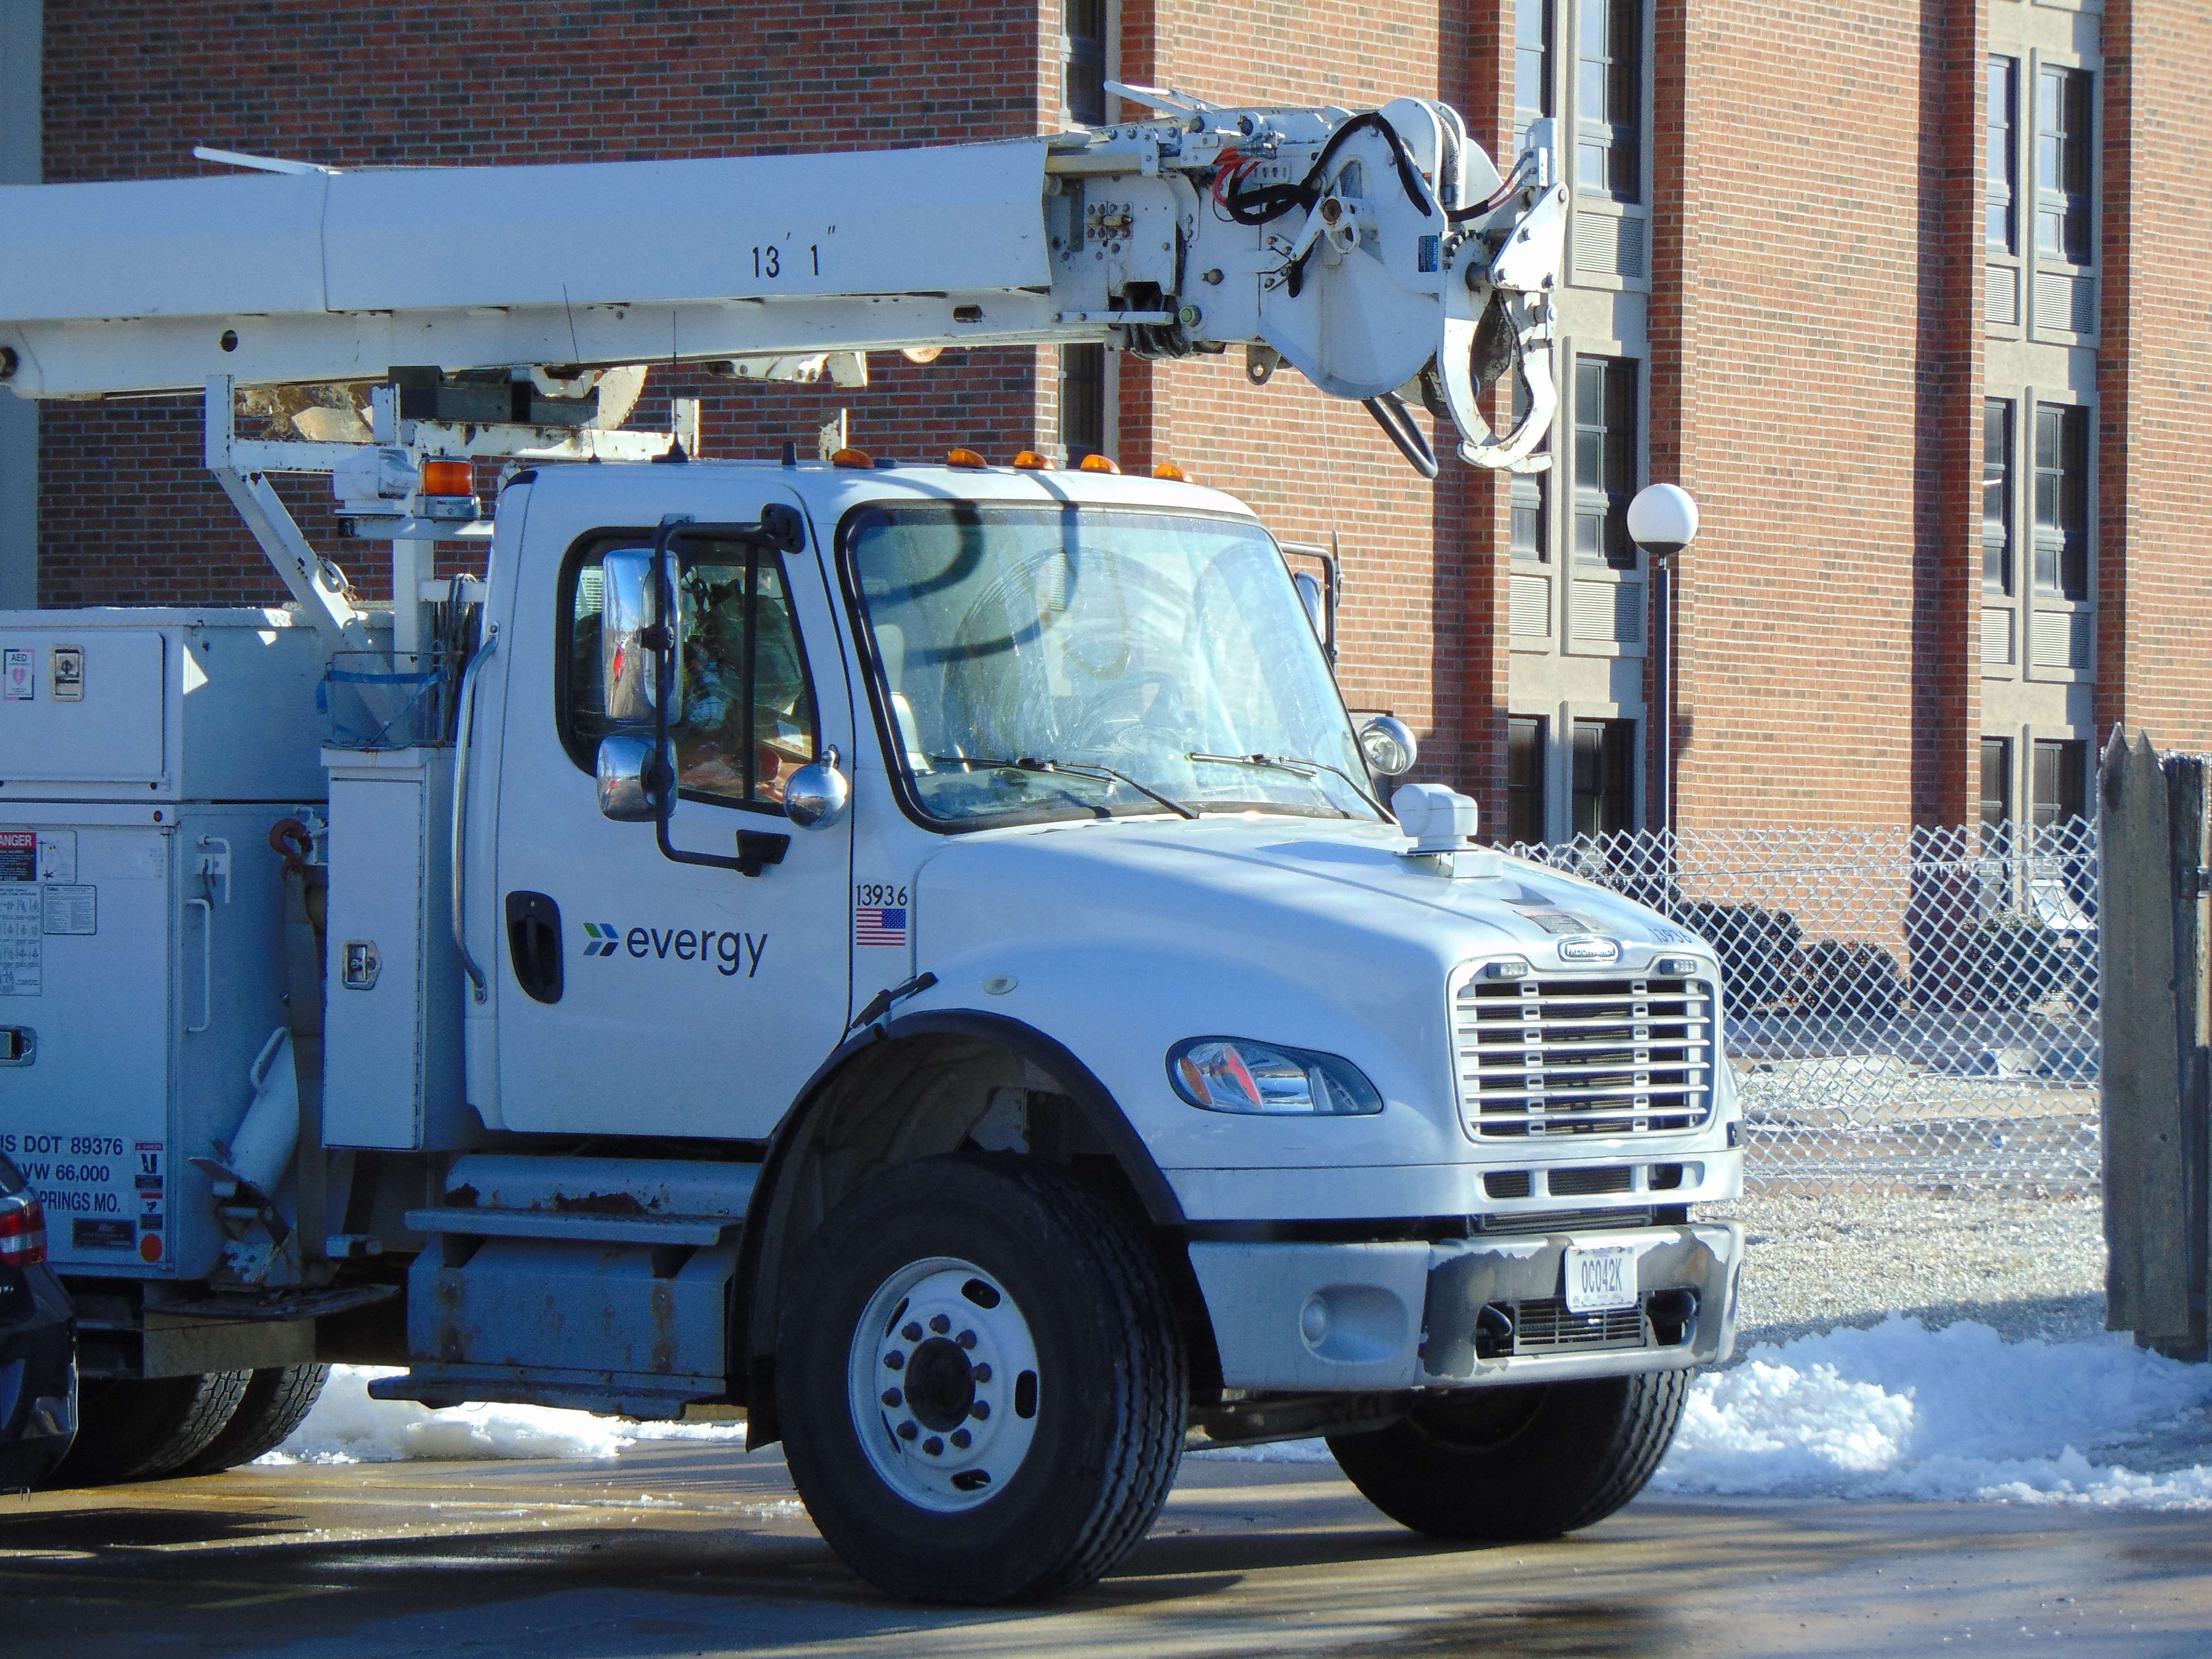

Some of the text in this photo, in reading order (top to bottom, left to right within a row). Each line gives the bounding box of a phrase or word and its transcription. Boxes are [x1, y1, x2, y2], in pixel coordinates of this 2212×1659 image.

[11, 653, 27, 662] AED
[0, 835, 32, 846] ANGER
[856, 884, 908, 906] 13936
[1649, 927, 1692, 944] 13936
[627, 927, 768, 978] evergy
[24, 1136, 62, 1154] DOT
[70, 1137, 123, 1155] 89376
[21, 1163, 109, 1182] VW 66,000
[40, 1191, 120, 1212] PRINGS MO.
